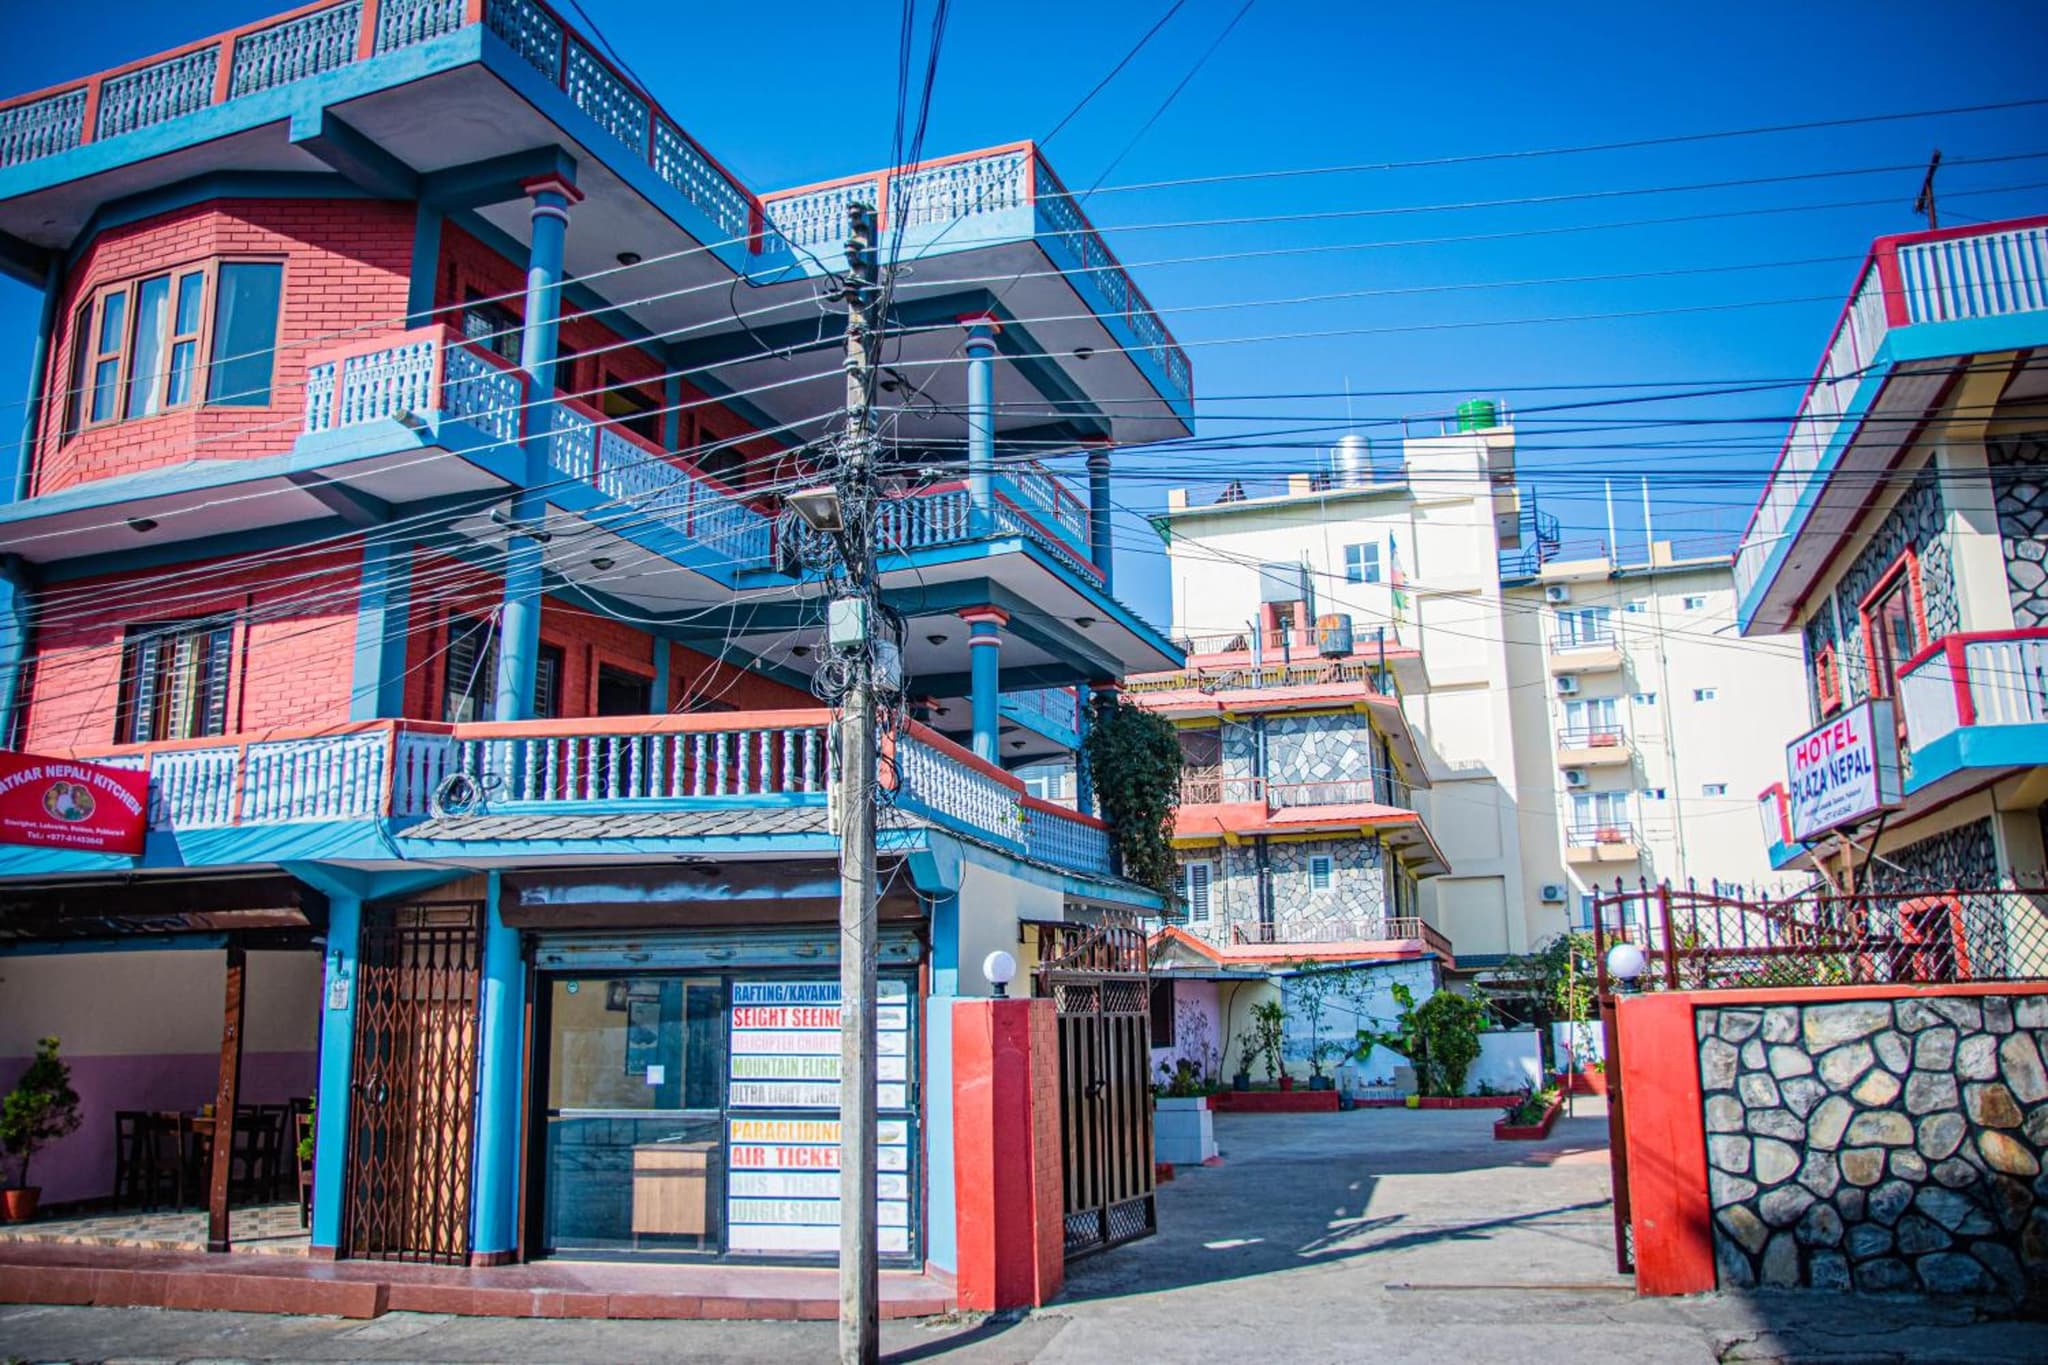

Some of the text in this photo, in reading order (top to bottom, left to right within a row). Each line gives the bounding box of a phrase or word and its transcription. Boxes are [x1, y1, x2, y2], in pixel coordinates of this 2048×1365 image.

[1796, 717, 1857, 770] HOTEL
[1791, 770, 1828, 807] PLAZA
[1829, 745, 1871, 789] NEPAL
[46, 765, 91, 781] NEPALI
[93, 773, 143, 817] KITCHEN
[734, 1006, 788, 1027] SEIGHT
[797, 1034, 841, 1051] CHARTE
[732, 1057, 840, 1077] MOUNTAIN FLIGH
[731, 1084, 765, 1102] ULTRA
[804, 1085, 840, 1104] FLIGH
[732, 1146, 765, 1166] AIR
[783, 1176, 840, 1195] TICKE
[731, 1202, 841, 1222] JUNGLE SAFAR
